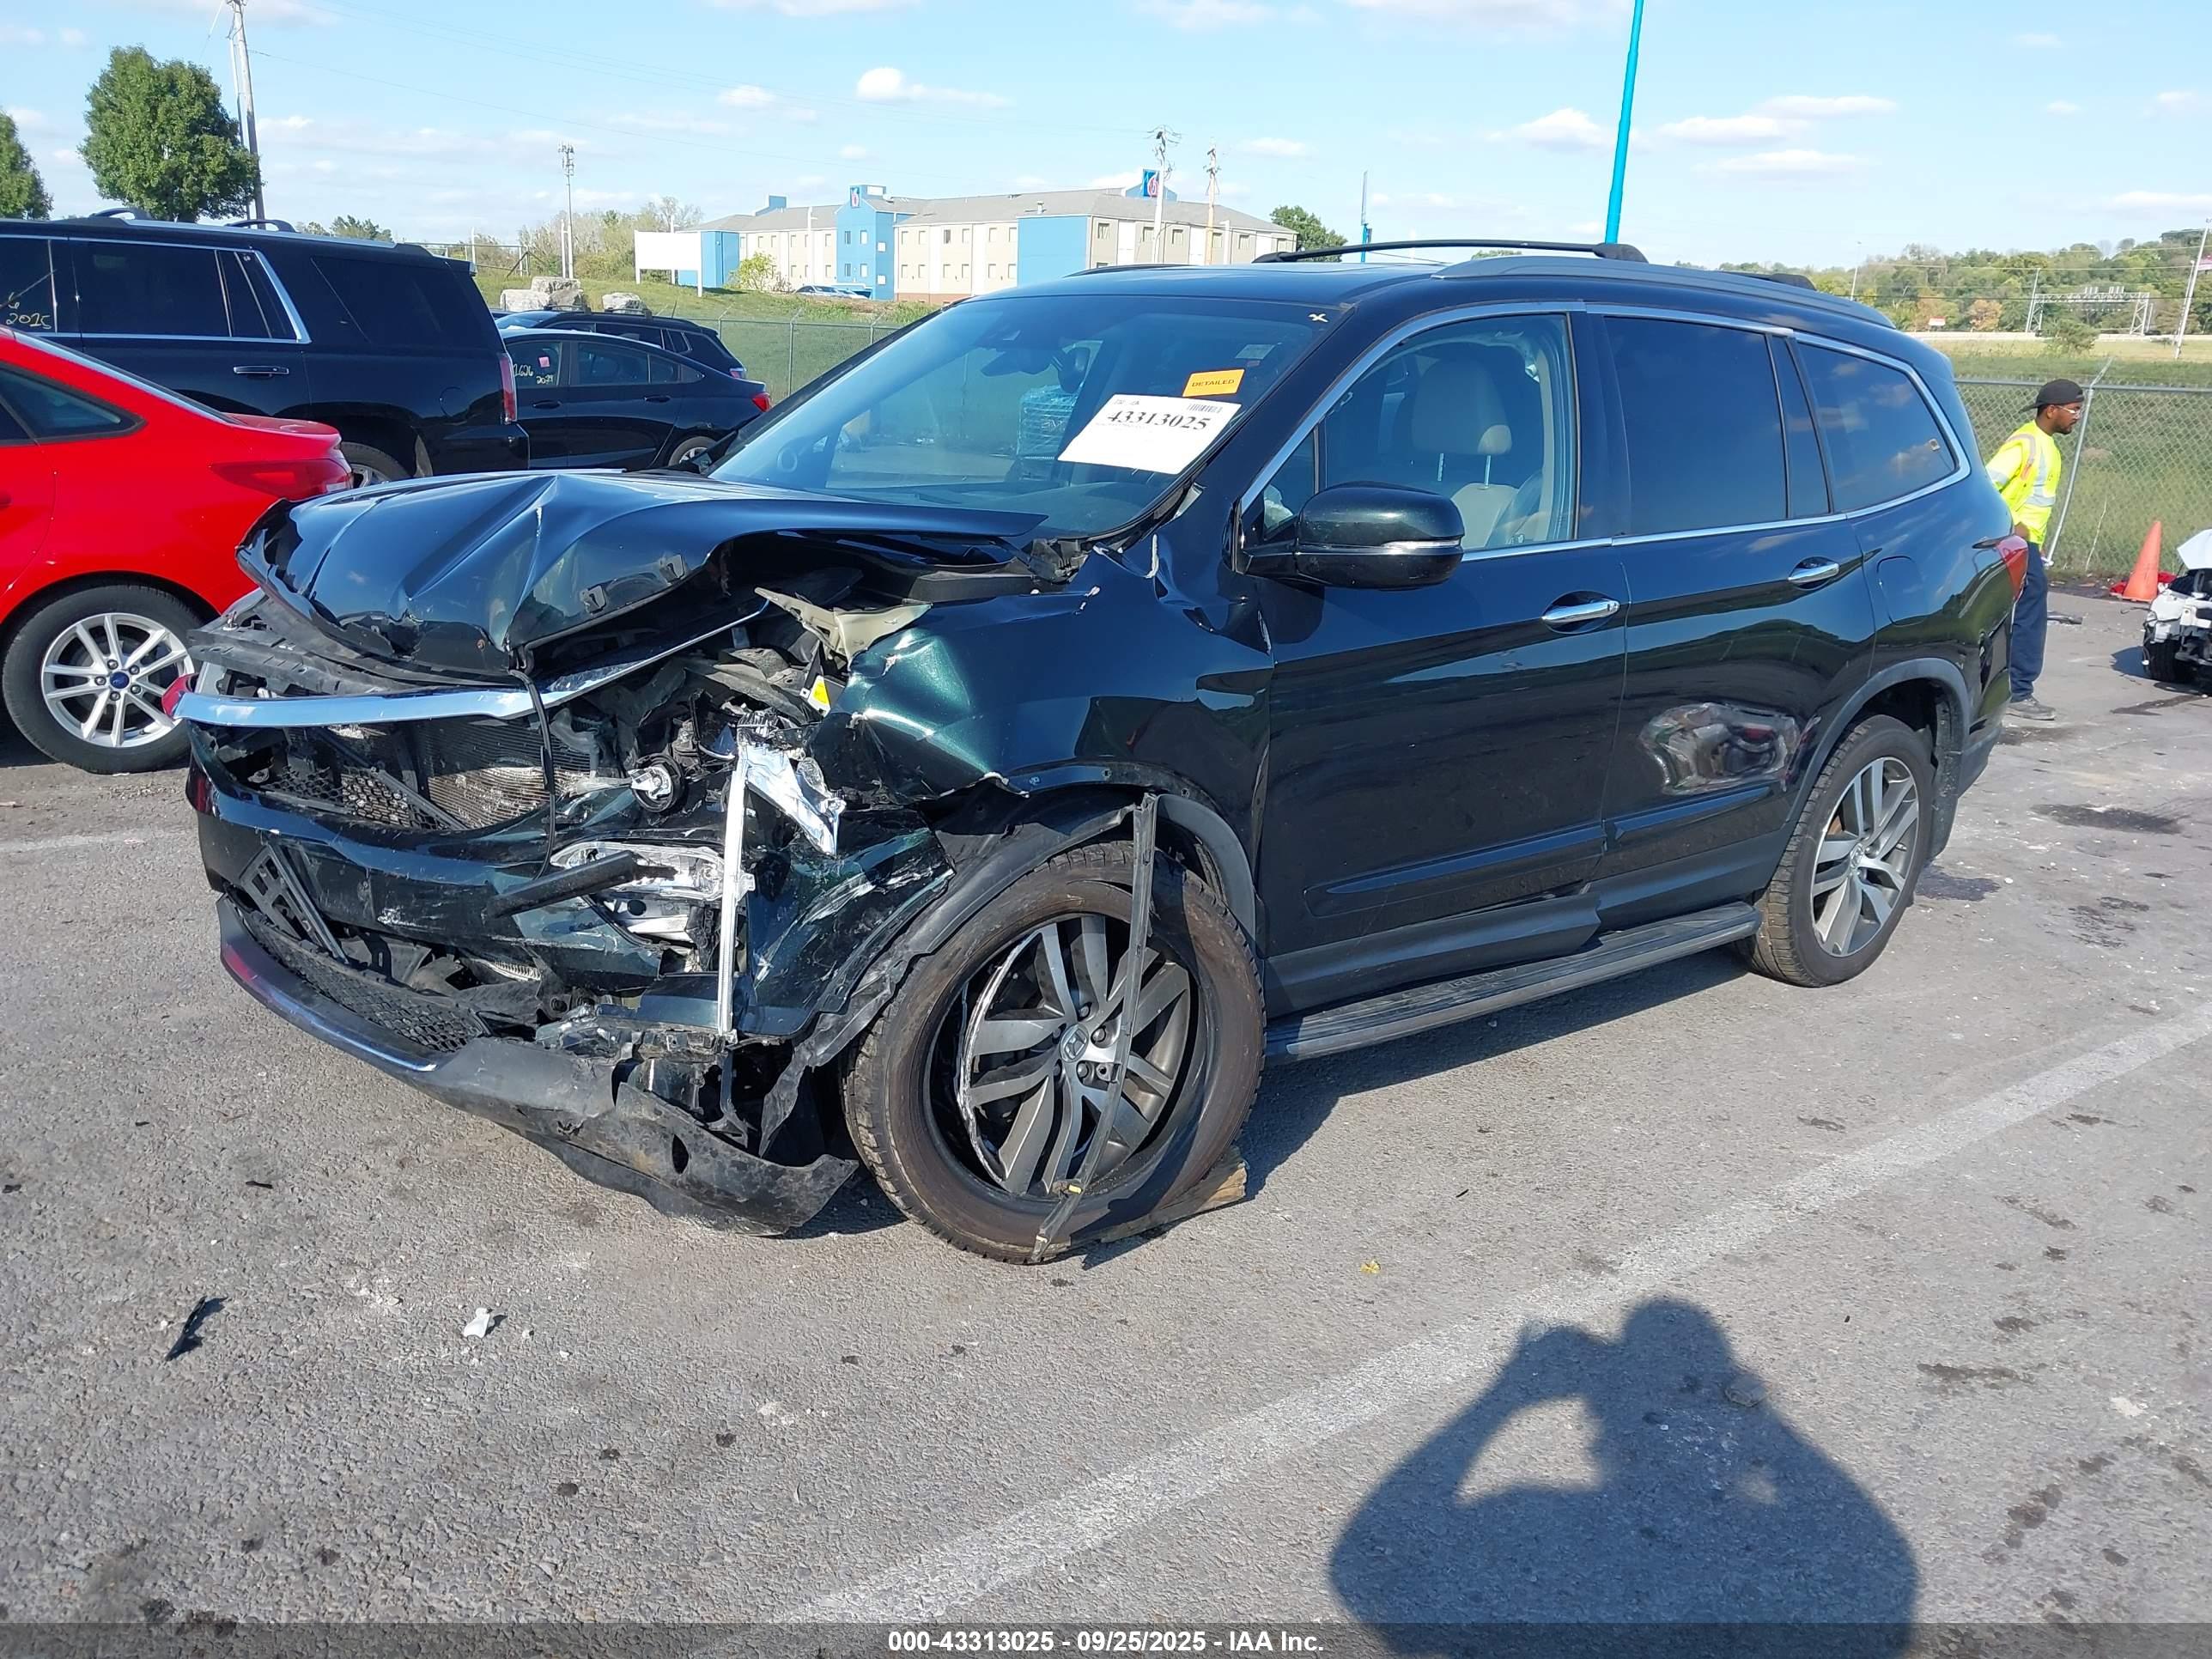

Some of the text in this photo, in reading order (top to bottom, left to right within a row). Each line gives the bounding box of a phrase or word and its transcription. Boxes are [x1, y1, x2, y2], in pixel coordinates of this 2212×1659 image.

[6, 313, 52, 330] 2015
[1191, 379, 1235, 387] DETAILED
[1107, 410, 1212, 431] 43313025
